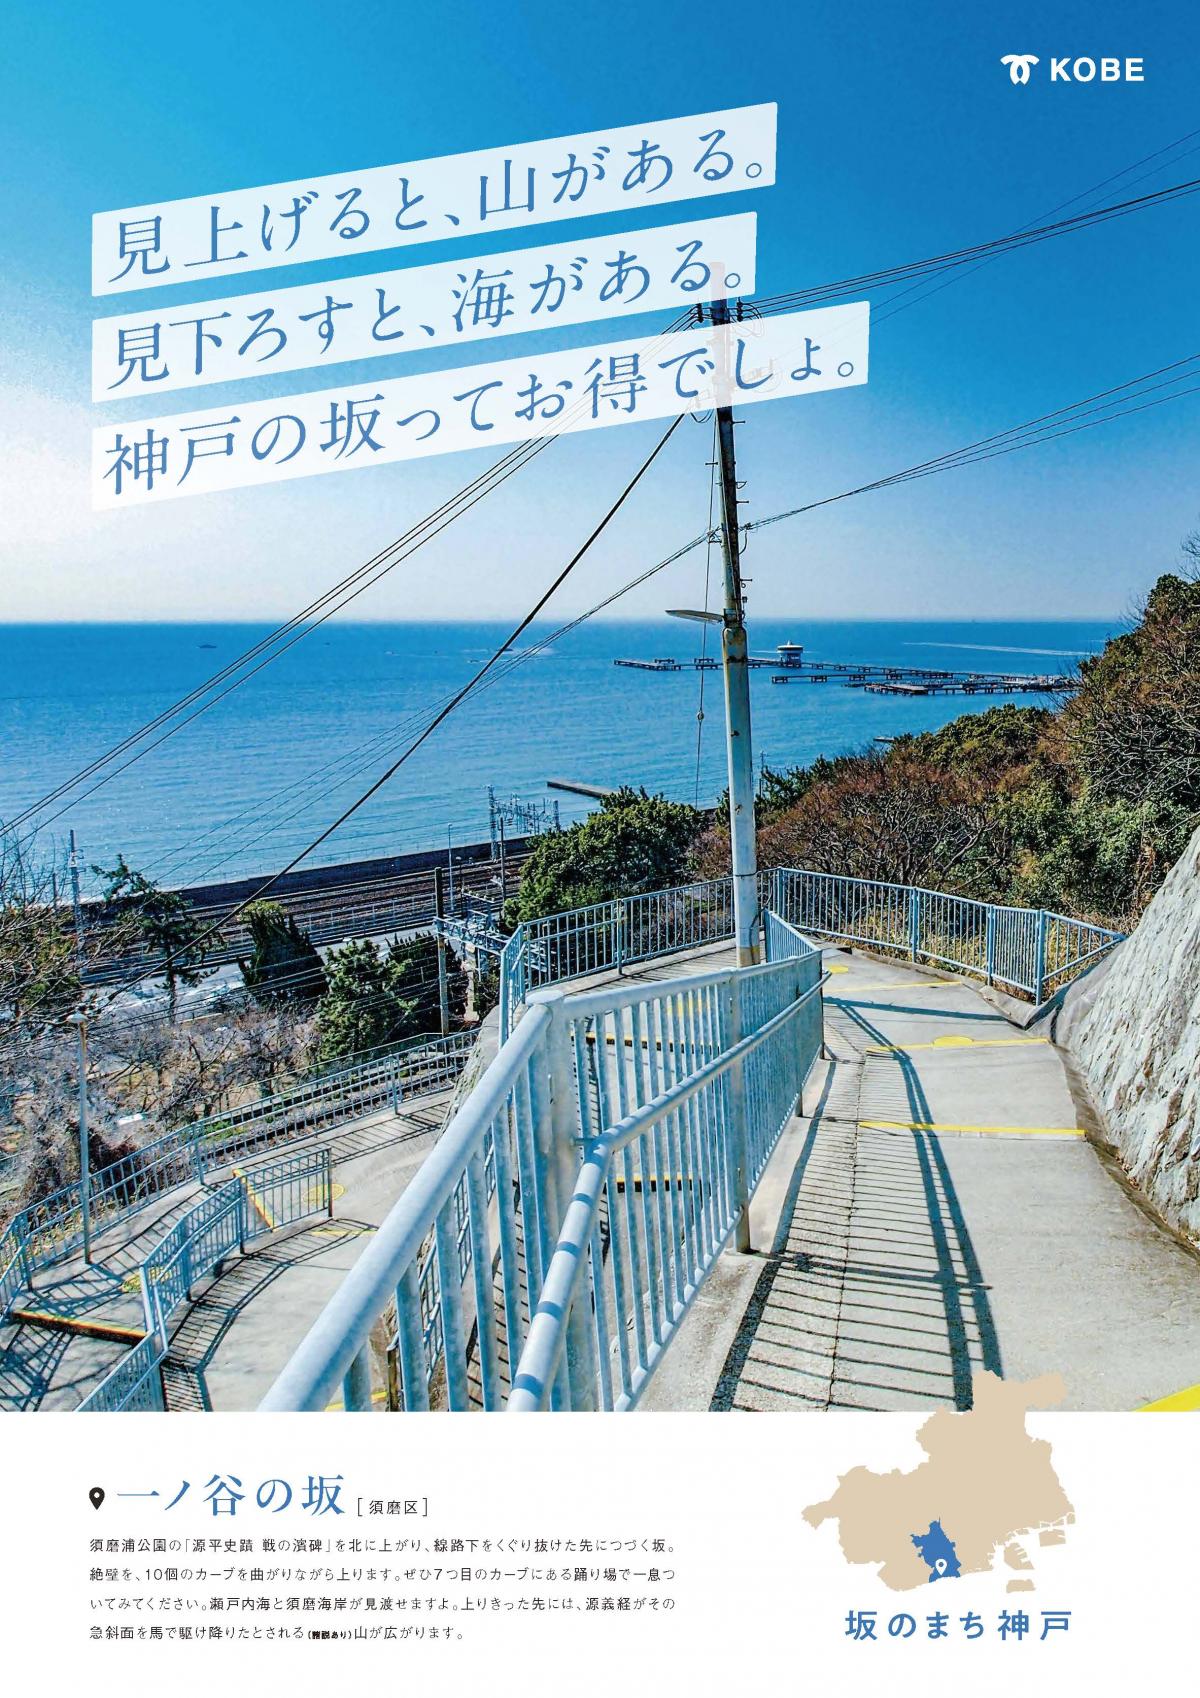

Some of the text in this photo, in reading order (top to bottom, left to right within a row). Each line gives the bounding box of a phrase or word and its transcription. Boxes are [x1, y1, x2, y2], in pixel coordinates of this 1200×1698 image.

[1050, 57, 1145, 81] KOBE
[107, 128, 764, 283] 見上げると、山がある。
[107, 239, 742, 390] 見下ろすと、海がある。
[103, 336, 854, 495] 神戸の坂ってお得でしょ。
[117, 1474, 345, 1517] 一ノ谷の坂
[844, 1609, 1072, 1641] 坂のまち神戸
